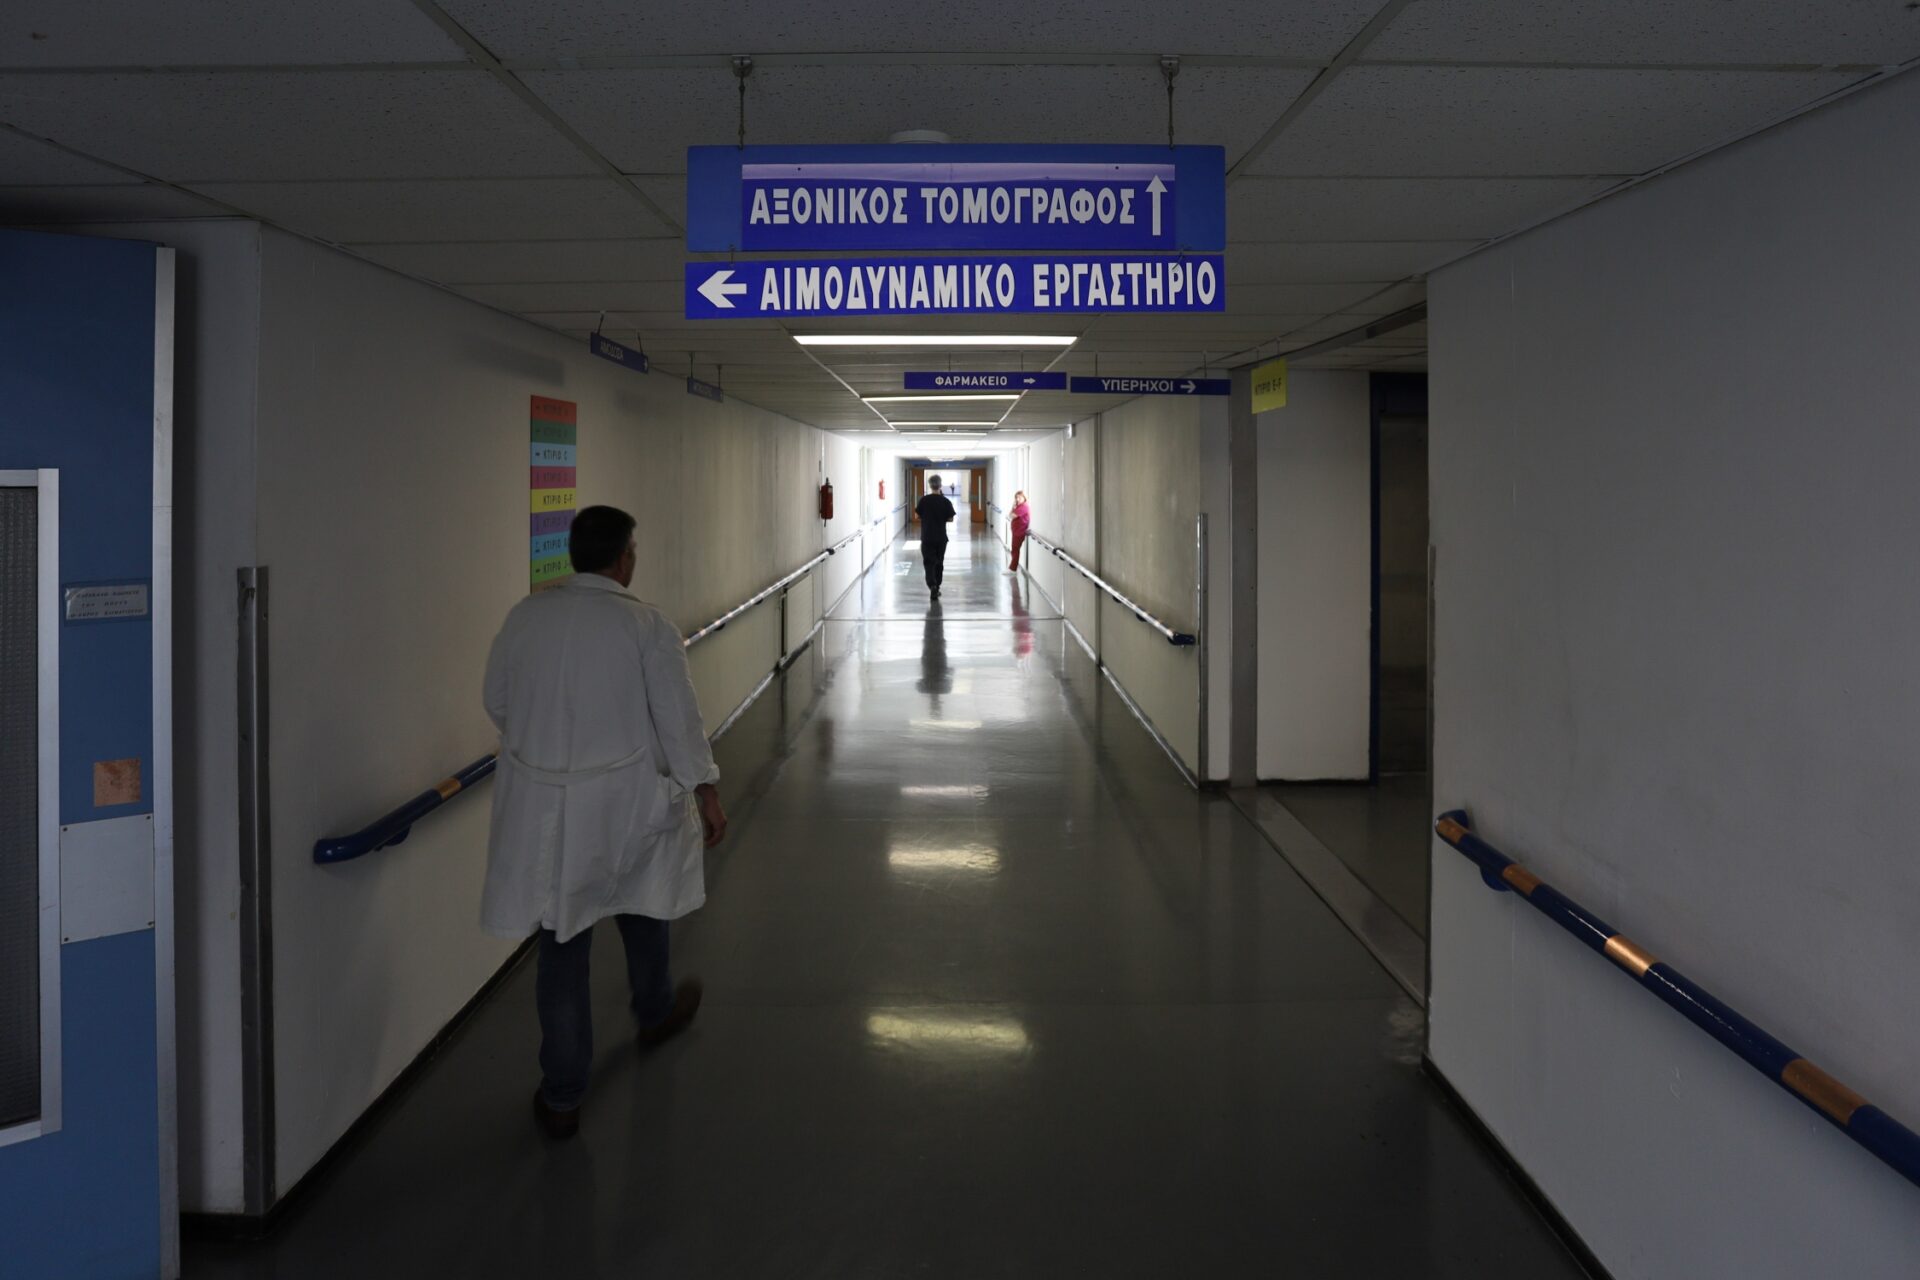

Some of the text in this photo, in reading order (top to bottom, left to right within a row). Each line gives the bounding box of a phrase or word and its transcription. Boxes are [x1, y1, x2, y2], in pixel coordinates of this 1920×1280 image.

[750, 186, 1136, 225] ΑΞΟΝΙΚΟΣ ΤΟΜΟΓΡΑΦΟΣ
[760, 260, 1217, 311] ΑΙΜΟΔΥΝΑΜΙΚΟ ΕΡΓΑΣΤΗΡΙΟ
[935, 376, 1008, 386] ΦΑΡΜΑΚΕΙΟ
[1101, 379, 1174, 392] ΥΠΕΡΗΧΟΙ
